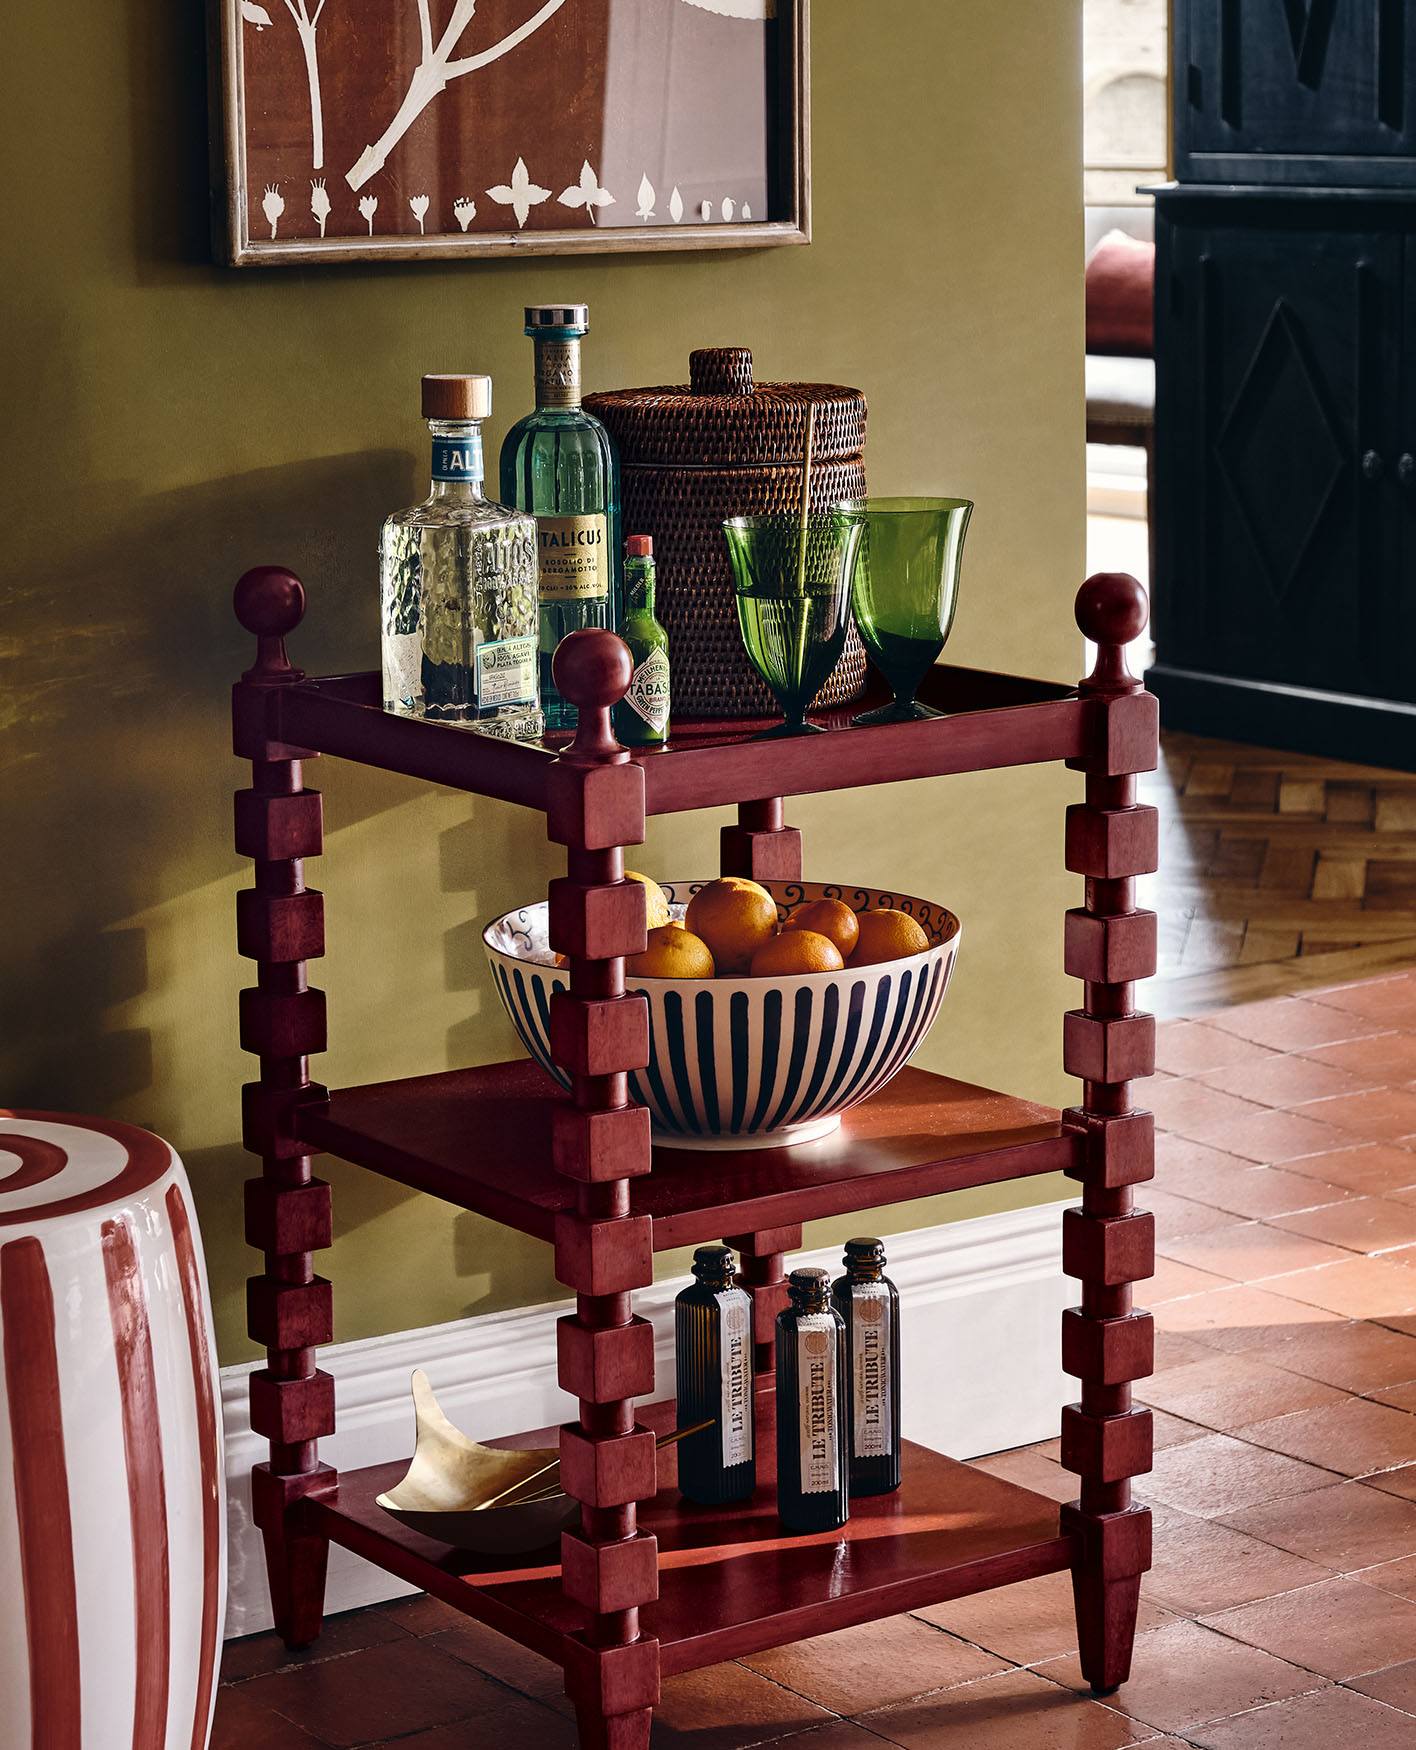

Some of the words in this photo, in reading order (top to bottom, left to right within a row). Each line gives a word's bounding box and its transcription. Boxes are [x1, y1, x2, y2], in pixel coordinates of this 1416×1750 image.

[542, 566, 597, 574] BERGAMOTTO
[731, 1336, 743, 1410] TRIBUTE
[865, 1330, 879, 1402] TRIBUTE
[811, 1362, 825, 1437] TRIBUTE
[731, 1411, 743, 1433] LE
[866, 1404, 879, 1425] LE
[812, 1438, 826, 1459] LE
